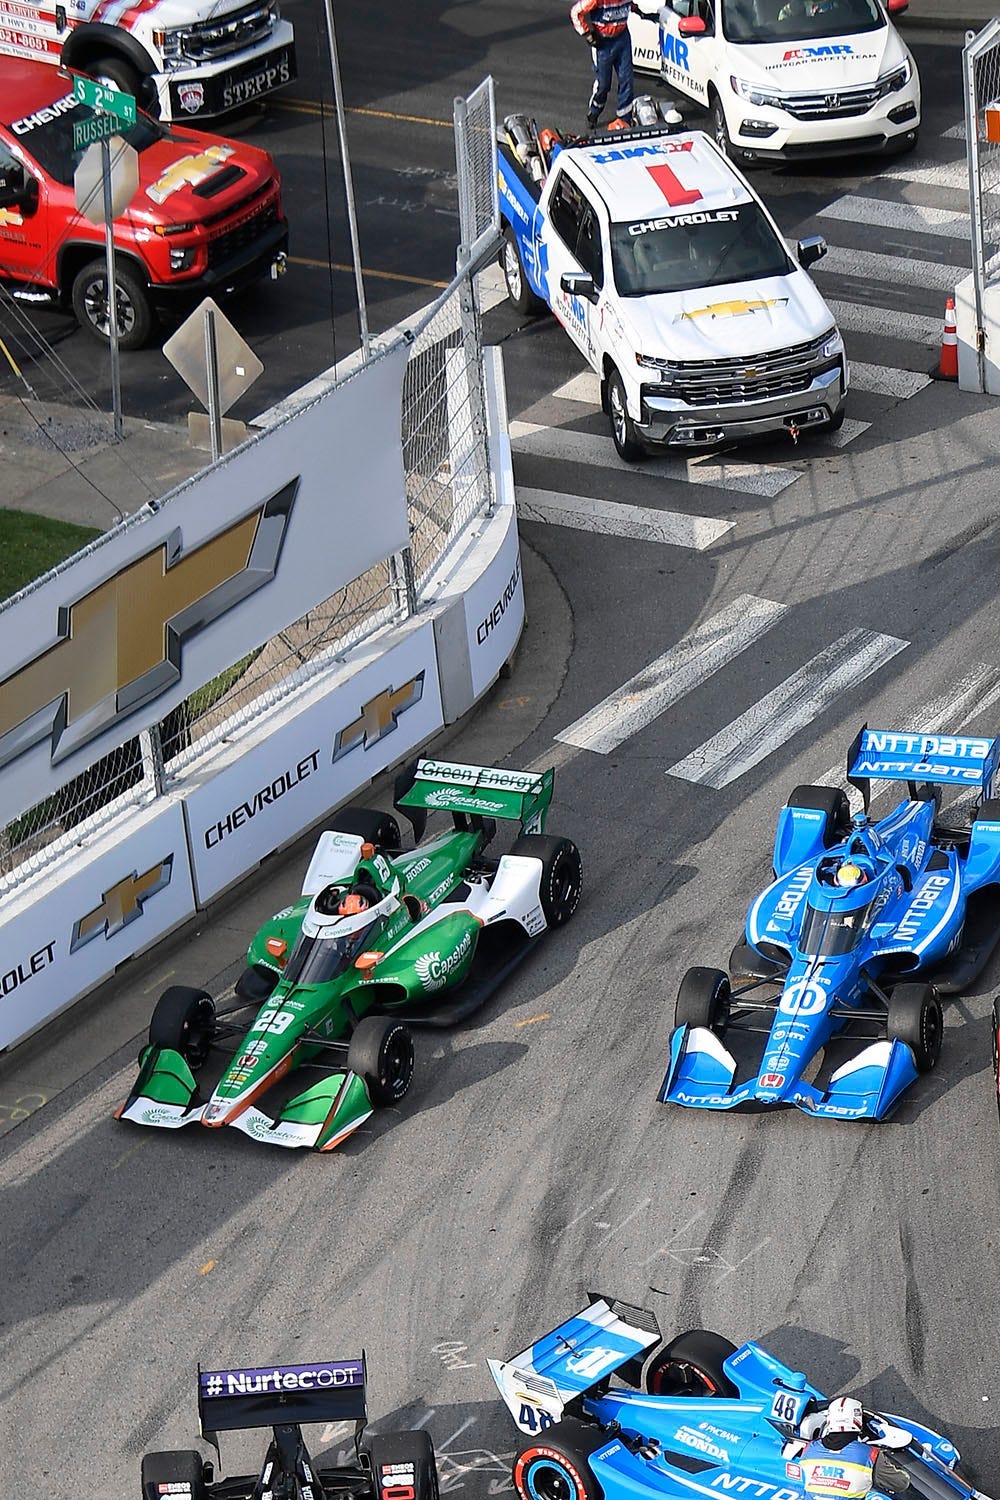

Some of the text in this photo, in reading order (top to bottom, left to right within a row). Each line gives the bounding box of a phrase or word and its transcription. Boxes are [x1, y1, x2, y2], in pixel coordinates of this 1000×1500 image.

[77, 80, 86, 100] S
[224, 63, 290, 106] STEPP'S
[75, 113, 122, 145] RUSSELL
[628, 209, 740, 236] CHEVROLET
[421, 760, 473, 781] Green
[204, 750, 320, 850] CHEVROLET
[789, 989, 817, 1011] 10
[252, 1009, 296, 1035] 29
[773, 1393, 797, 1421] 48
[673, 1429, 731, 1463] HONDA
